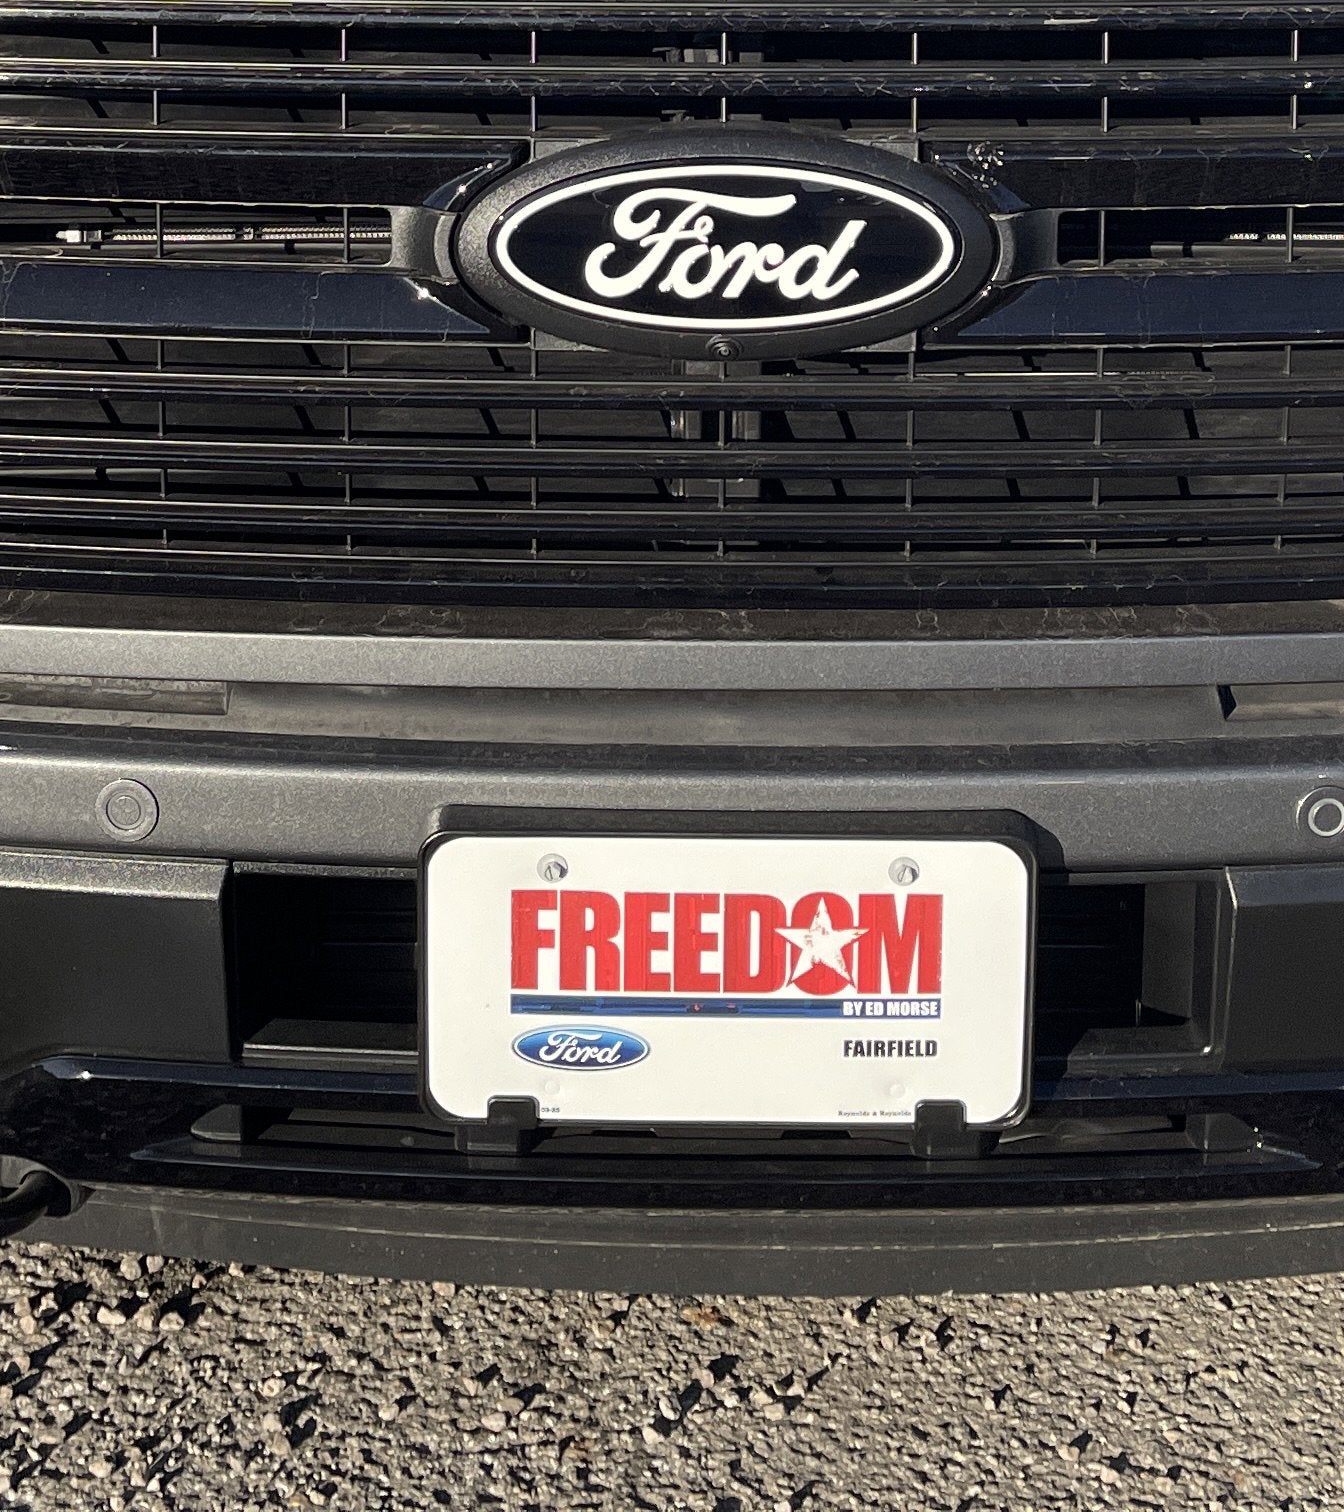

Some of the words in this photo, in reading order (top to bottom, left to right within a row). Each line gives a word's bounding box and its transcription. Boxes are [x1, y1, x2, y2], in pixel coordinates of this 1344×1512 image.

[584, 187, 867, 301] Ford
[511, 889, 943, 996] FREEDOM
[842, 1001, 863, 1017] BY
[865, 1001, 884, 1017] ED
[886, 1001, 939, 1017] MORSE
[538, 1032, 624, 1064] Ford
[843, 1040, 938, 1058] FAIRFIELD
